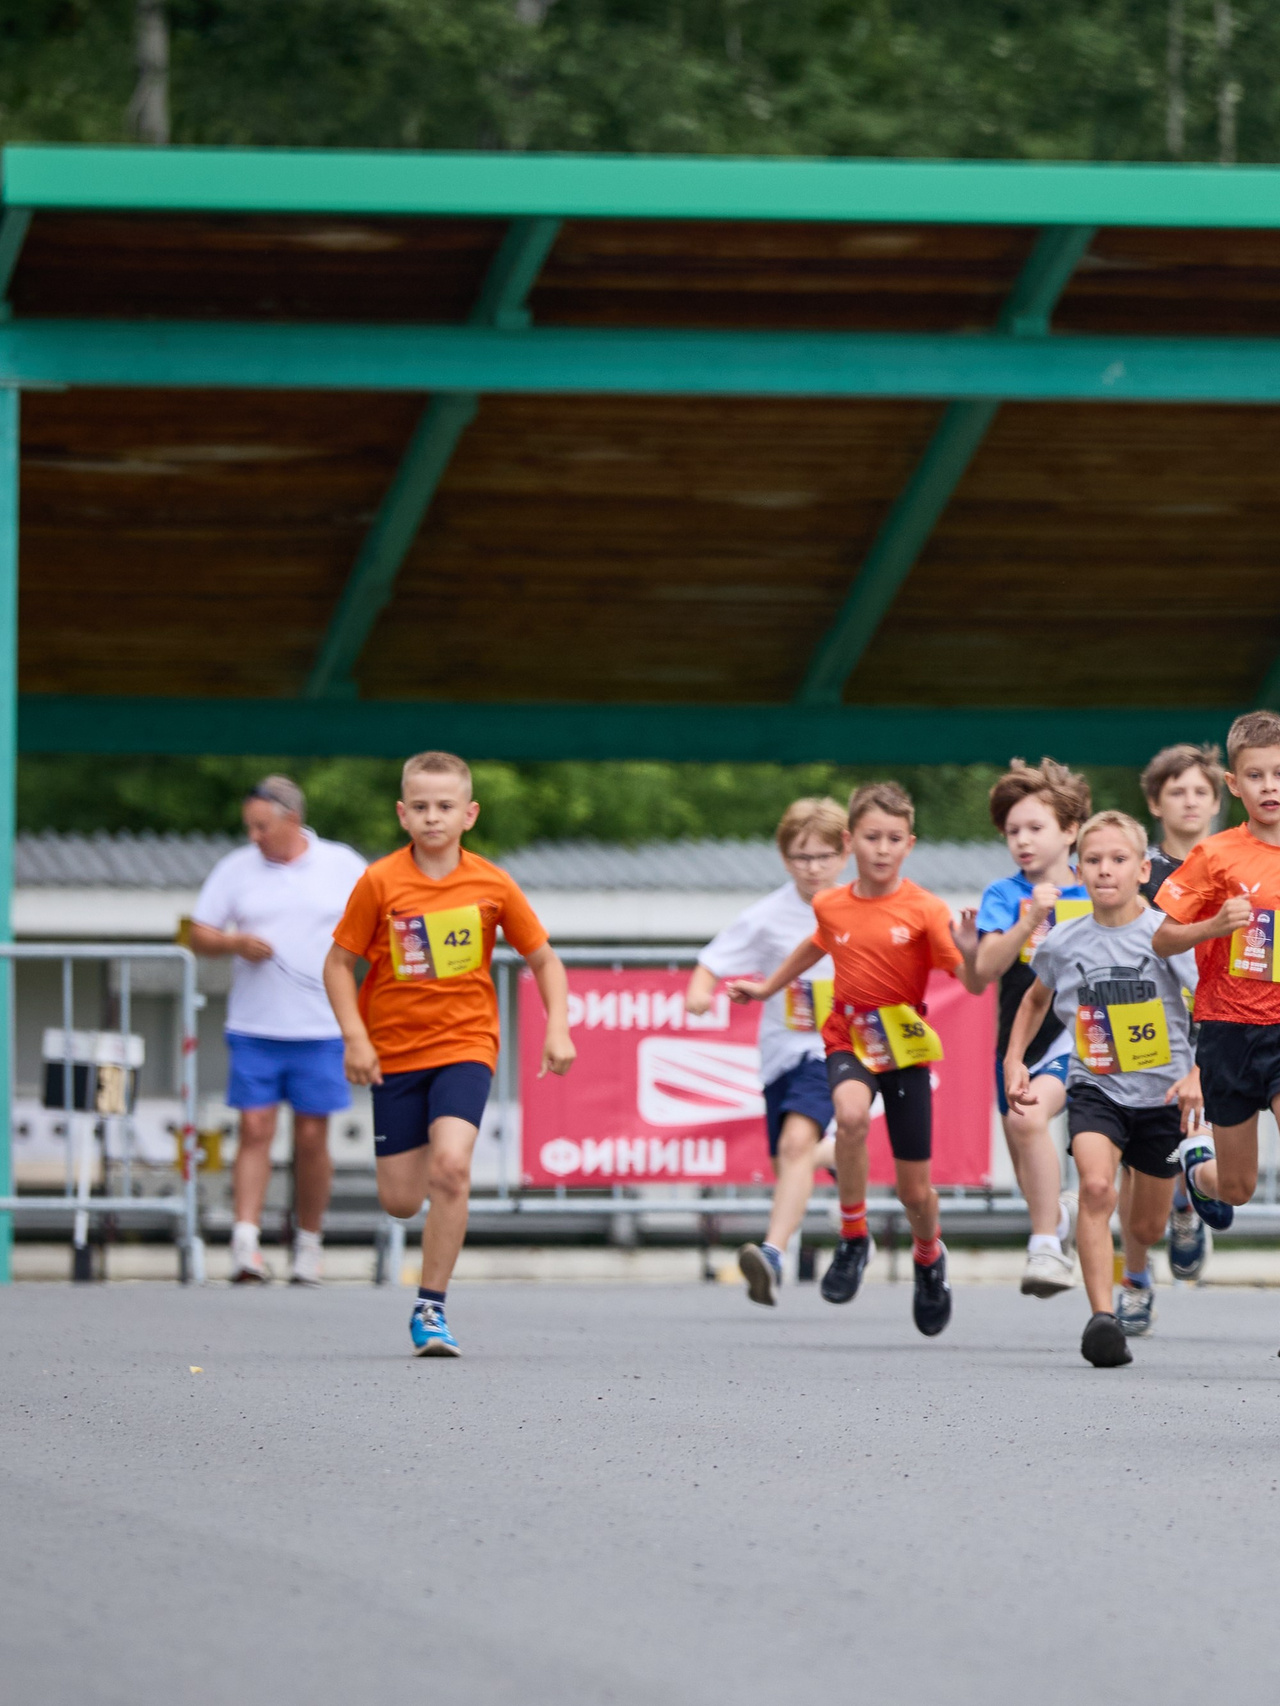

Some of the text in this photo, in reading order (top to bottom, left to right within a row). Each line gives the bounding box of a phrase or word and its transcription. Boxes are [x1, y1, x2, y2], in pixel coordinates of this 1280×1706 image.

[444, 928, 473, 948] 42
[1077, 979, 1157, 1006] ВЫМПЕЛ
[899, 1021, 926, 1039] 38
[1127, 1022, 1156, 1043] 36
[539, 1136, 727, 1176] ФИНИШ
